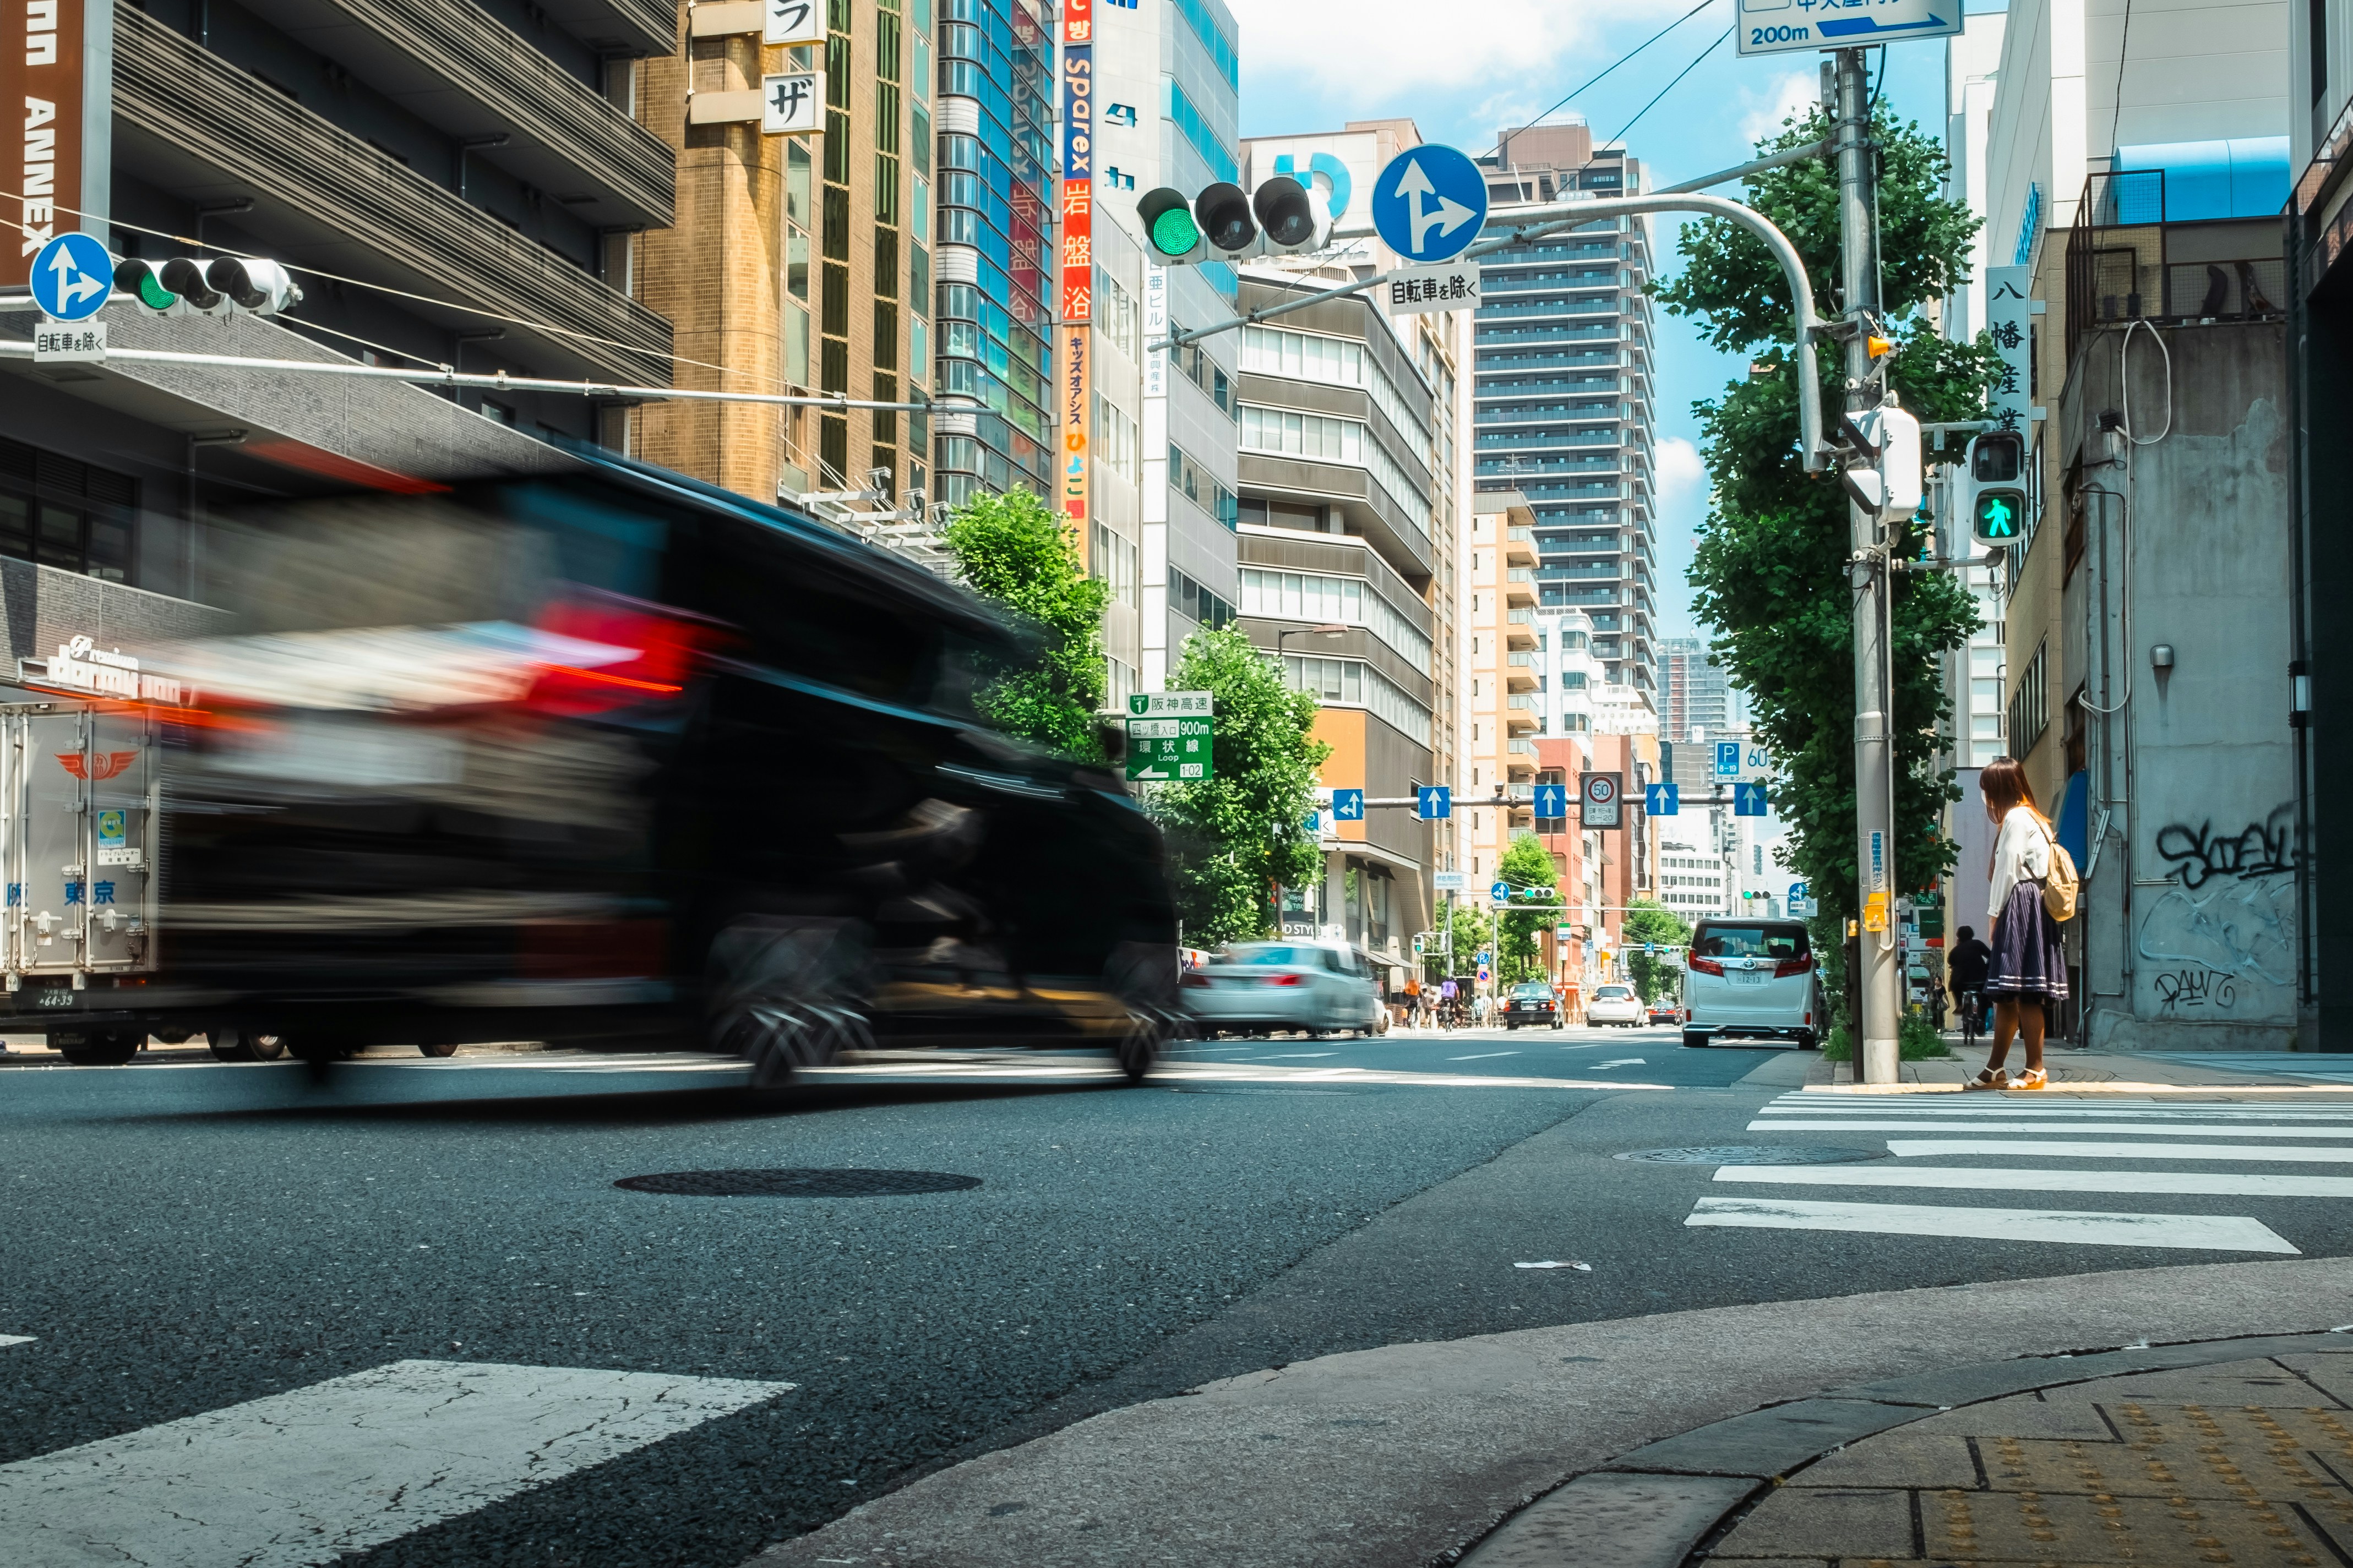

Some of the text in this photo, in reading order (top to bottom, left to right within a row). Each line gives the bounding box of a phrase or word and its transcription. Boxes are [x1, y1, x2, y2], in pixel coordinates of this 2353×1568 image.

[1751, 25, 1809, 45] 200m
[1065, 57, 1091, 172] Sparex
[22, 96, 55, 257] ANNEX
[1064, 183, 1091, 318] 岩盤浴
[1392, 275, 1476, 304] 自転車を除く
[38, 332, 102, 352] 自転車を除く
[1991, 281, 2025, 431] 八幡産業
[1070, 337, 1083, 425] キッズオアシス
[1066, 433, 1086, 495] ひよこ
[1152, 697, 1207, 711] 阪神高速
[1132, 721, 1209, 736] 四ツ橋入口 900m
[1139, 739, 1199, 753] 環状線
[1724, 745, 1735, 763] P
[1594, 784, 1609, 796] 50
[64, 880, 116, 906] 東京
